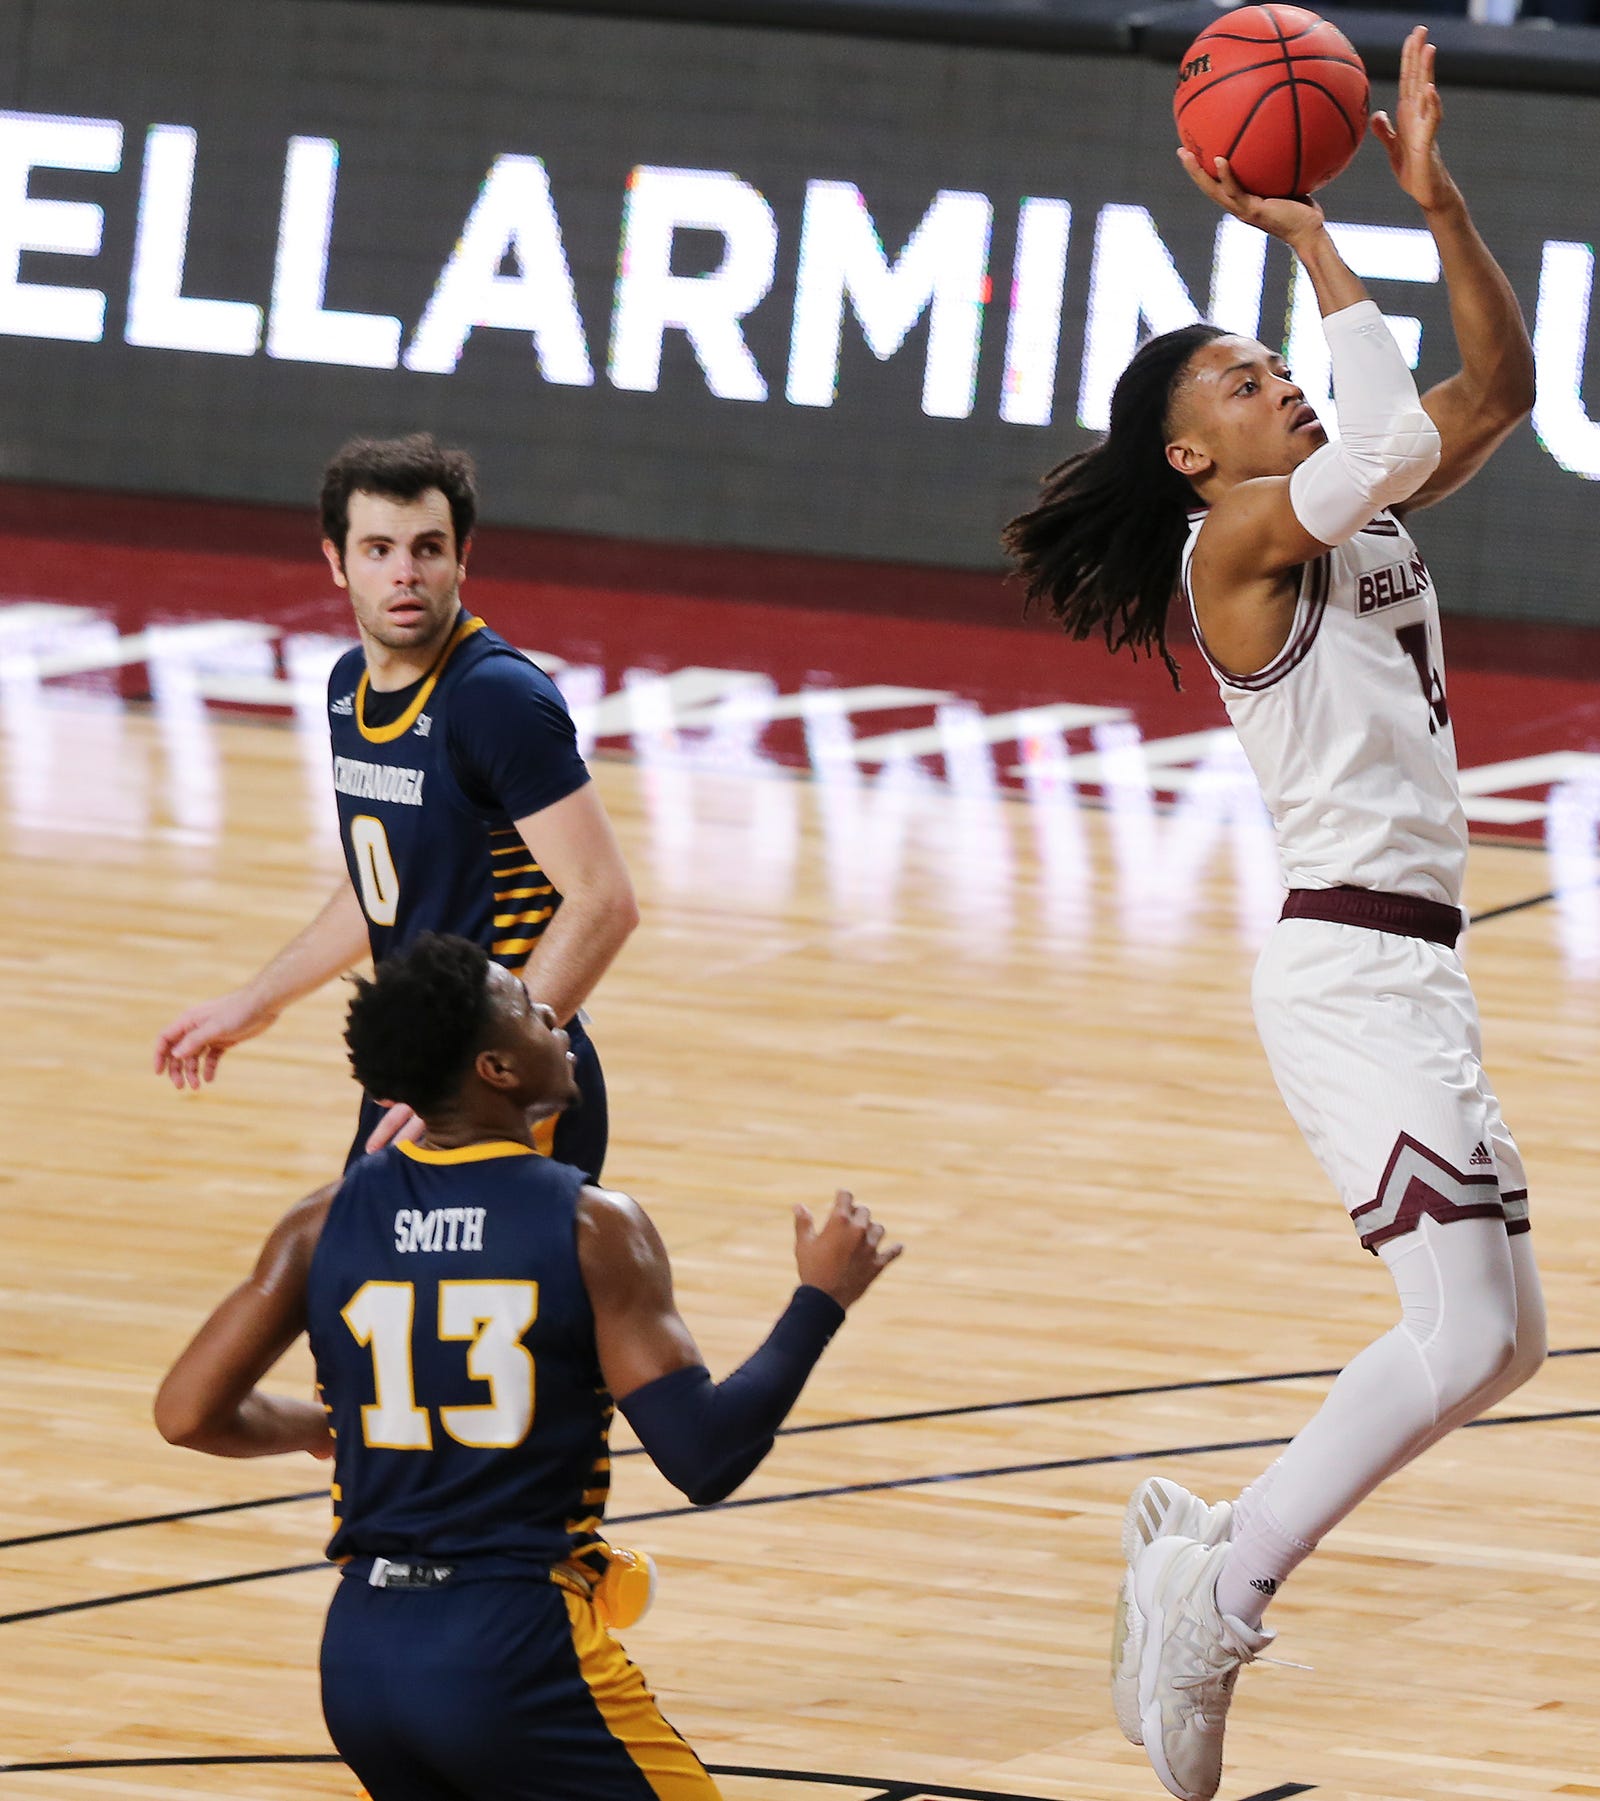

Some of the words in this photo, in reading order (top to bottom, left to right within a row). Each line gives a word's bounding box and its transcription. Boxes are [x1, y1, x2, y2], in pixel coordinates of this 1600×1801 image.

[350, 814, 400, 927] 0
[393, 1207, 487, 1254] SMITH
[339, 1279, 540, 1451] 13
